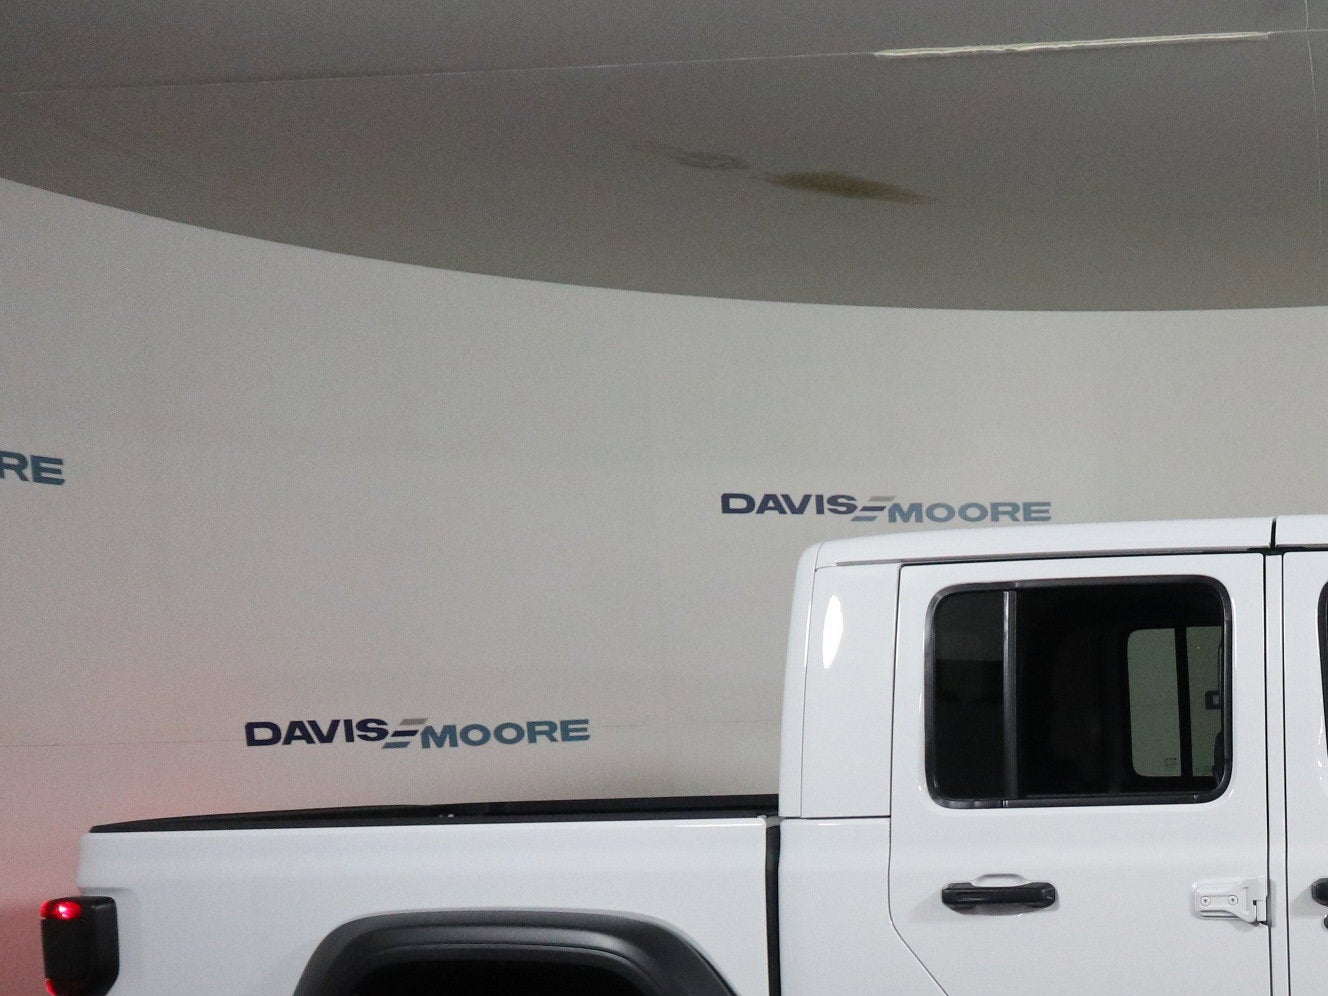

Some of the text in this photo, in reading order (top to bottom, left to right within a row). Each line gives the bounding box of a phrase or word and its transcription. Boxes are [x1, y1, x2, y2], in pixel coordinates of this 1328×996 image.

[721, 493, 1052, 524] DAVIS MOORE
[244, 718, 591, 749] DAVIS MOORE
